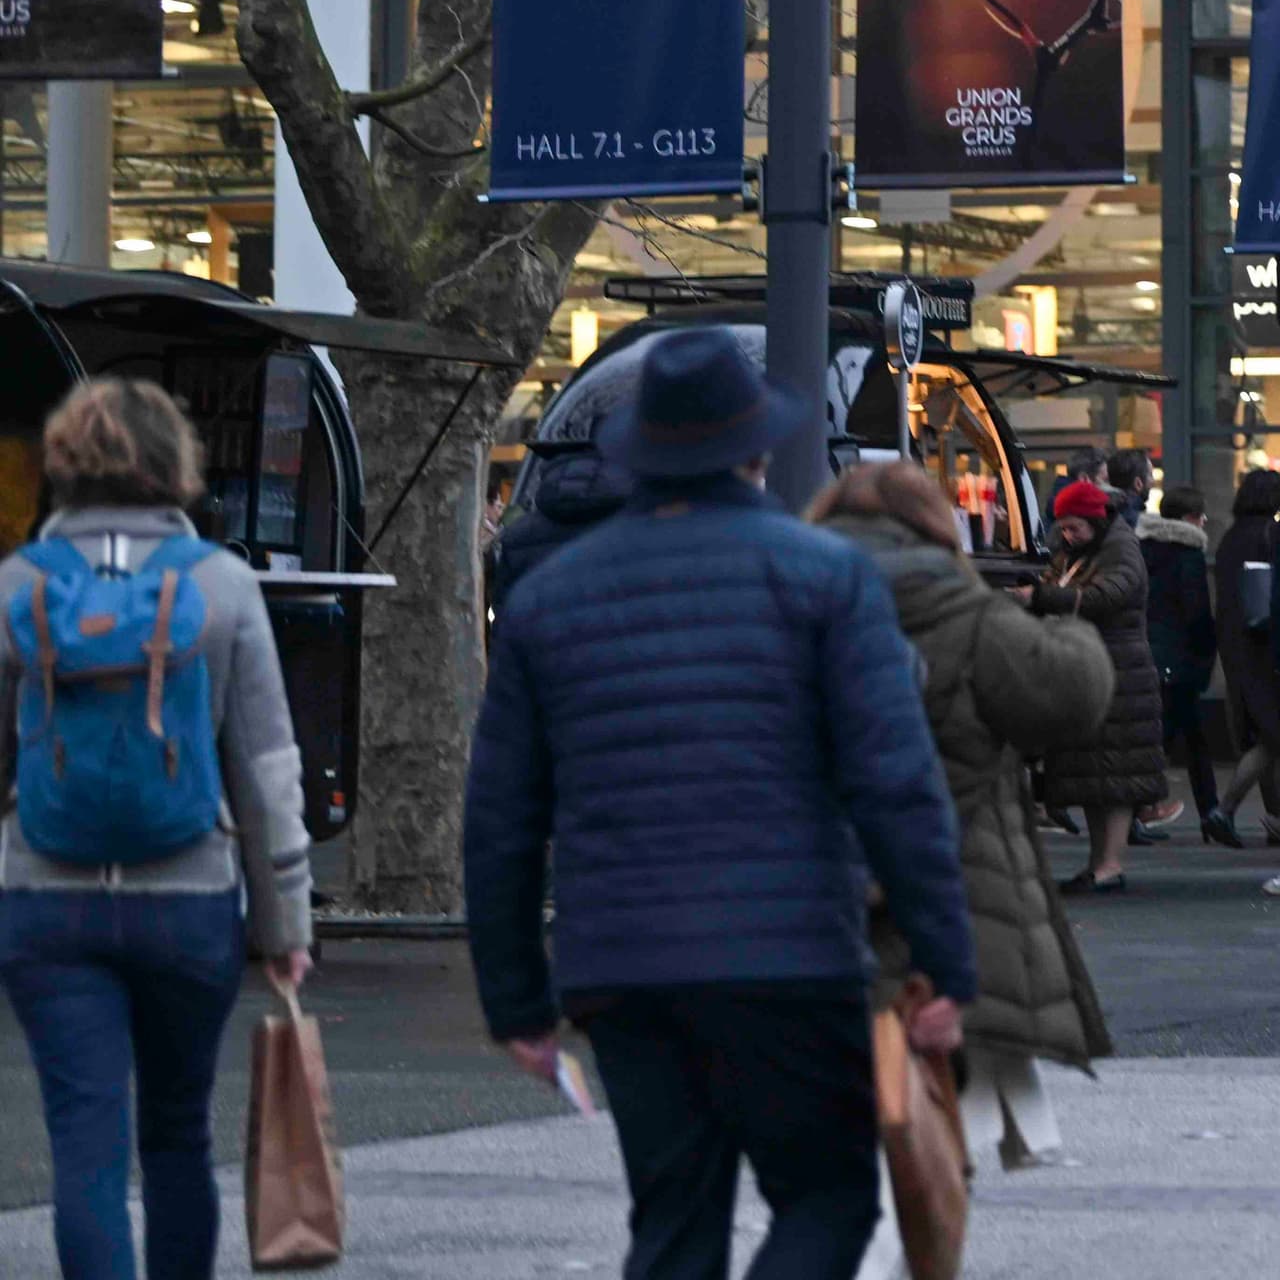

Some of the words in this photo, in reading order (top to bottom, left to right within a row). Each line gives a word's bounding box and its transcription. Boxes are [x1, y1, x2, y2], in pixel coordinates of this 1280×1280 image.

[957, 87, 1021, 108] UNION
[945, 106, 1033, 127] GRANDS
[517, 133, 584, 160] HALL
[592, 131, 625, 159] 7.1
[653, 127, 716, 157] G113
[962, 126, 1016, 146] CRUS
